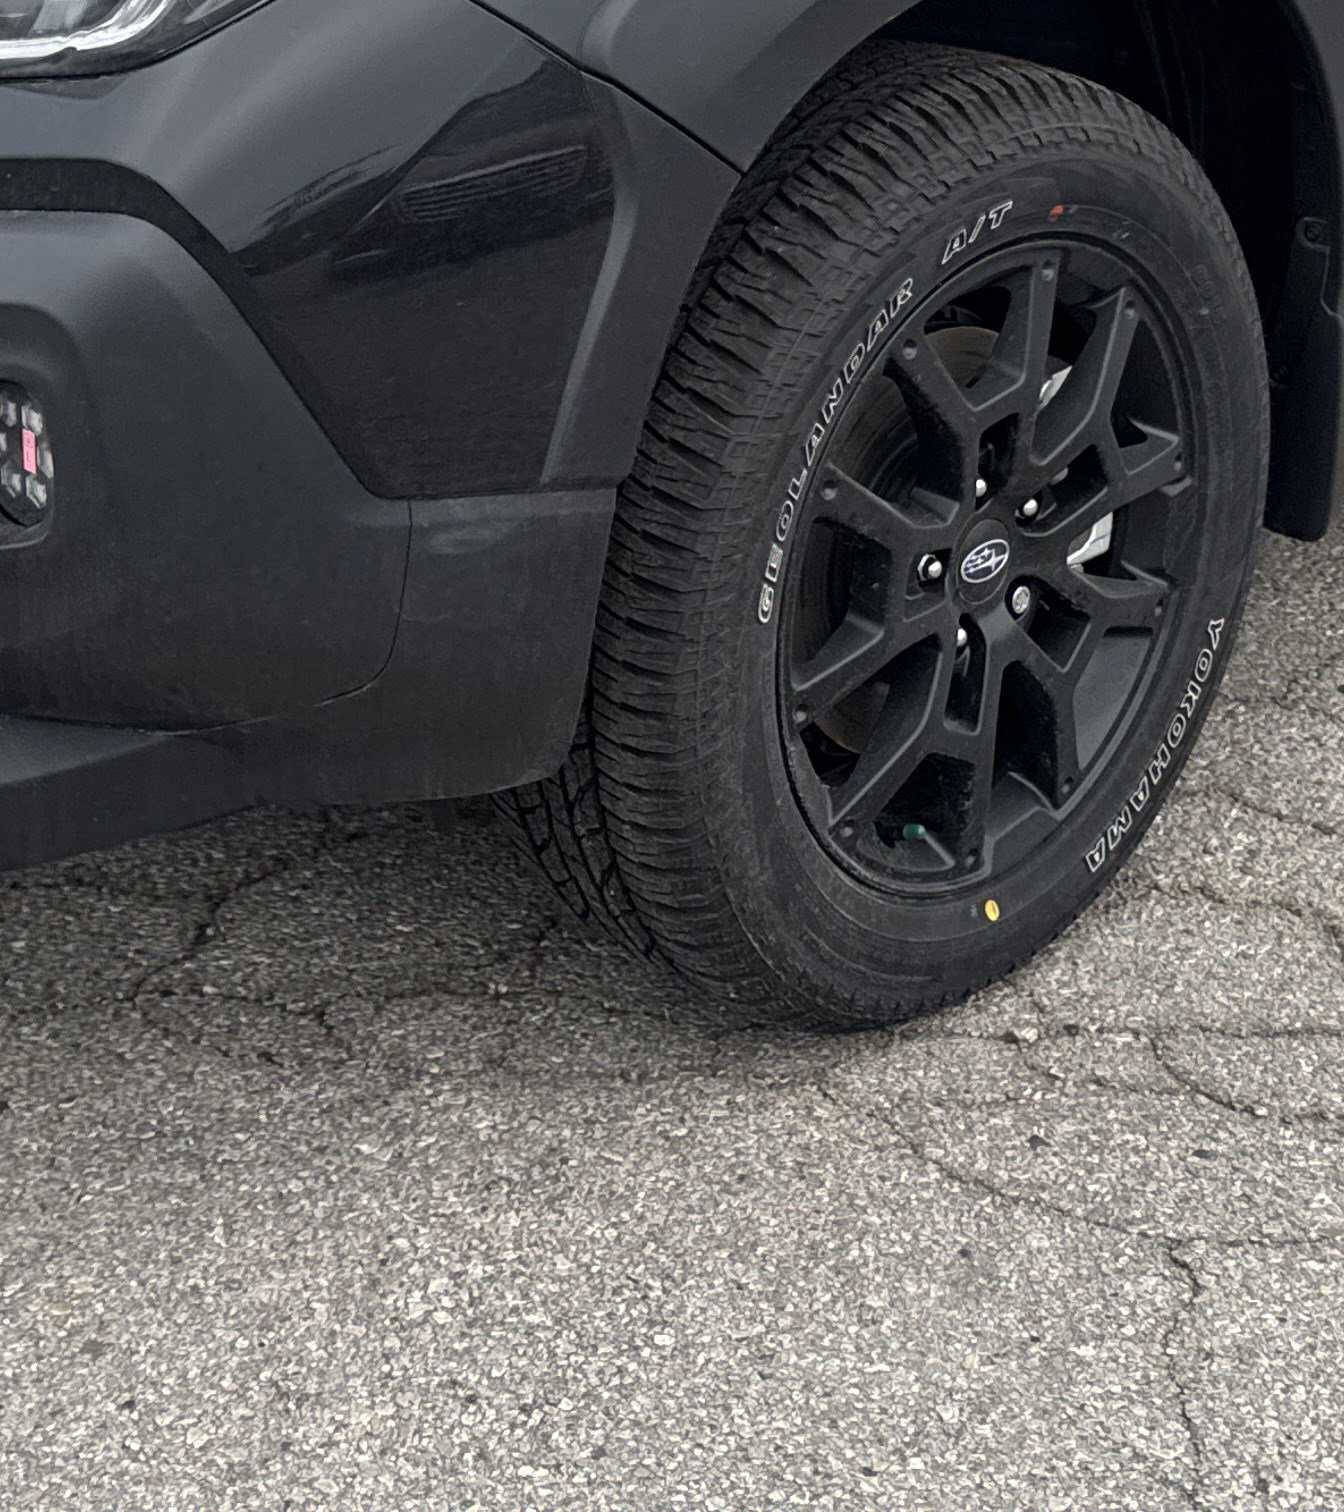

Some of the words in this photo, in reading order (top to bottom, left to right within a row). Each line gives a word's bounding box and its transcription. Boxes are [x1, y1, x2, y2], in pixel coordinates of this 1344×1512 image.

[758, 277, 914, 624] GEOLANDAR
[941, 200, 1014, 265] A/T
[1085, 617, 1225, 873] YOKOHAMA
